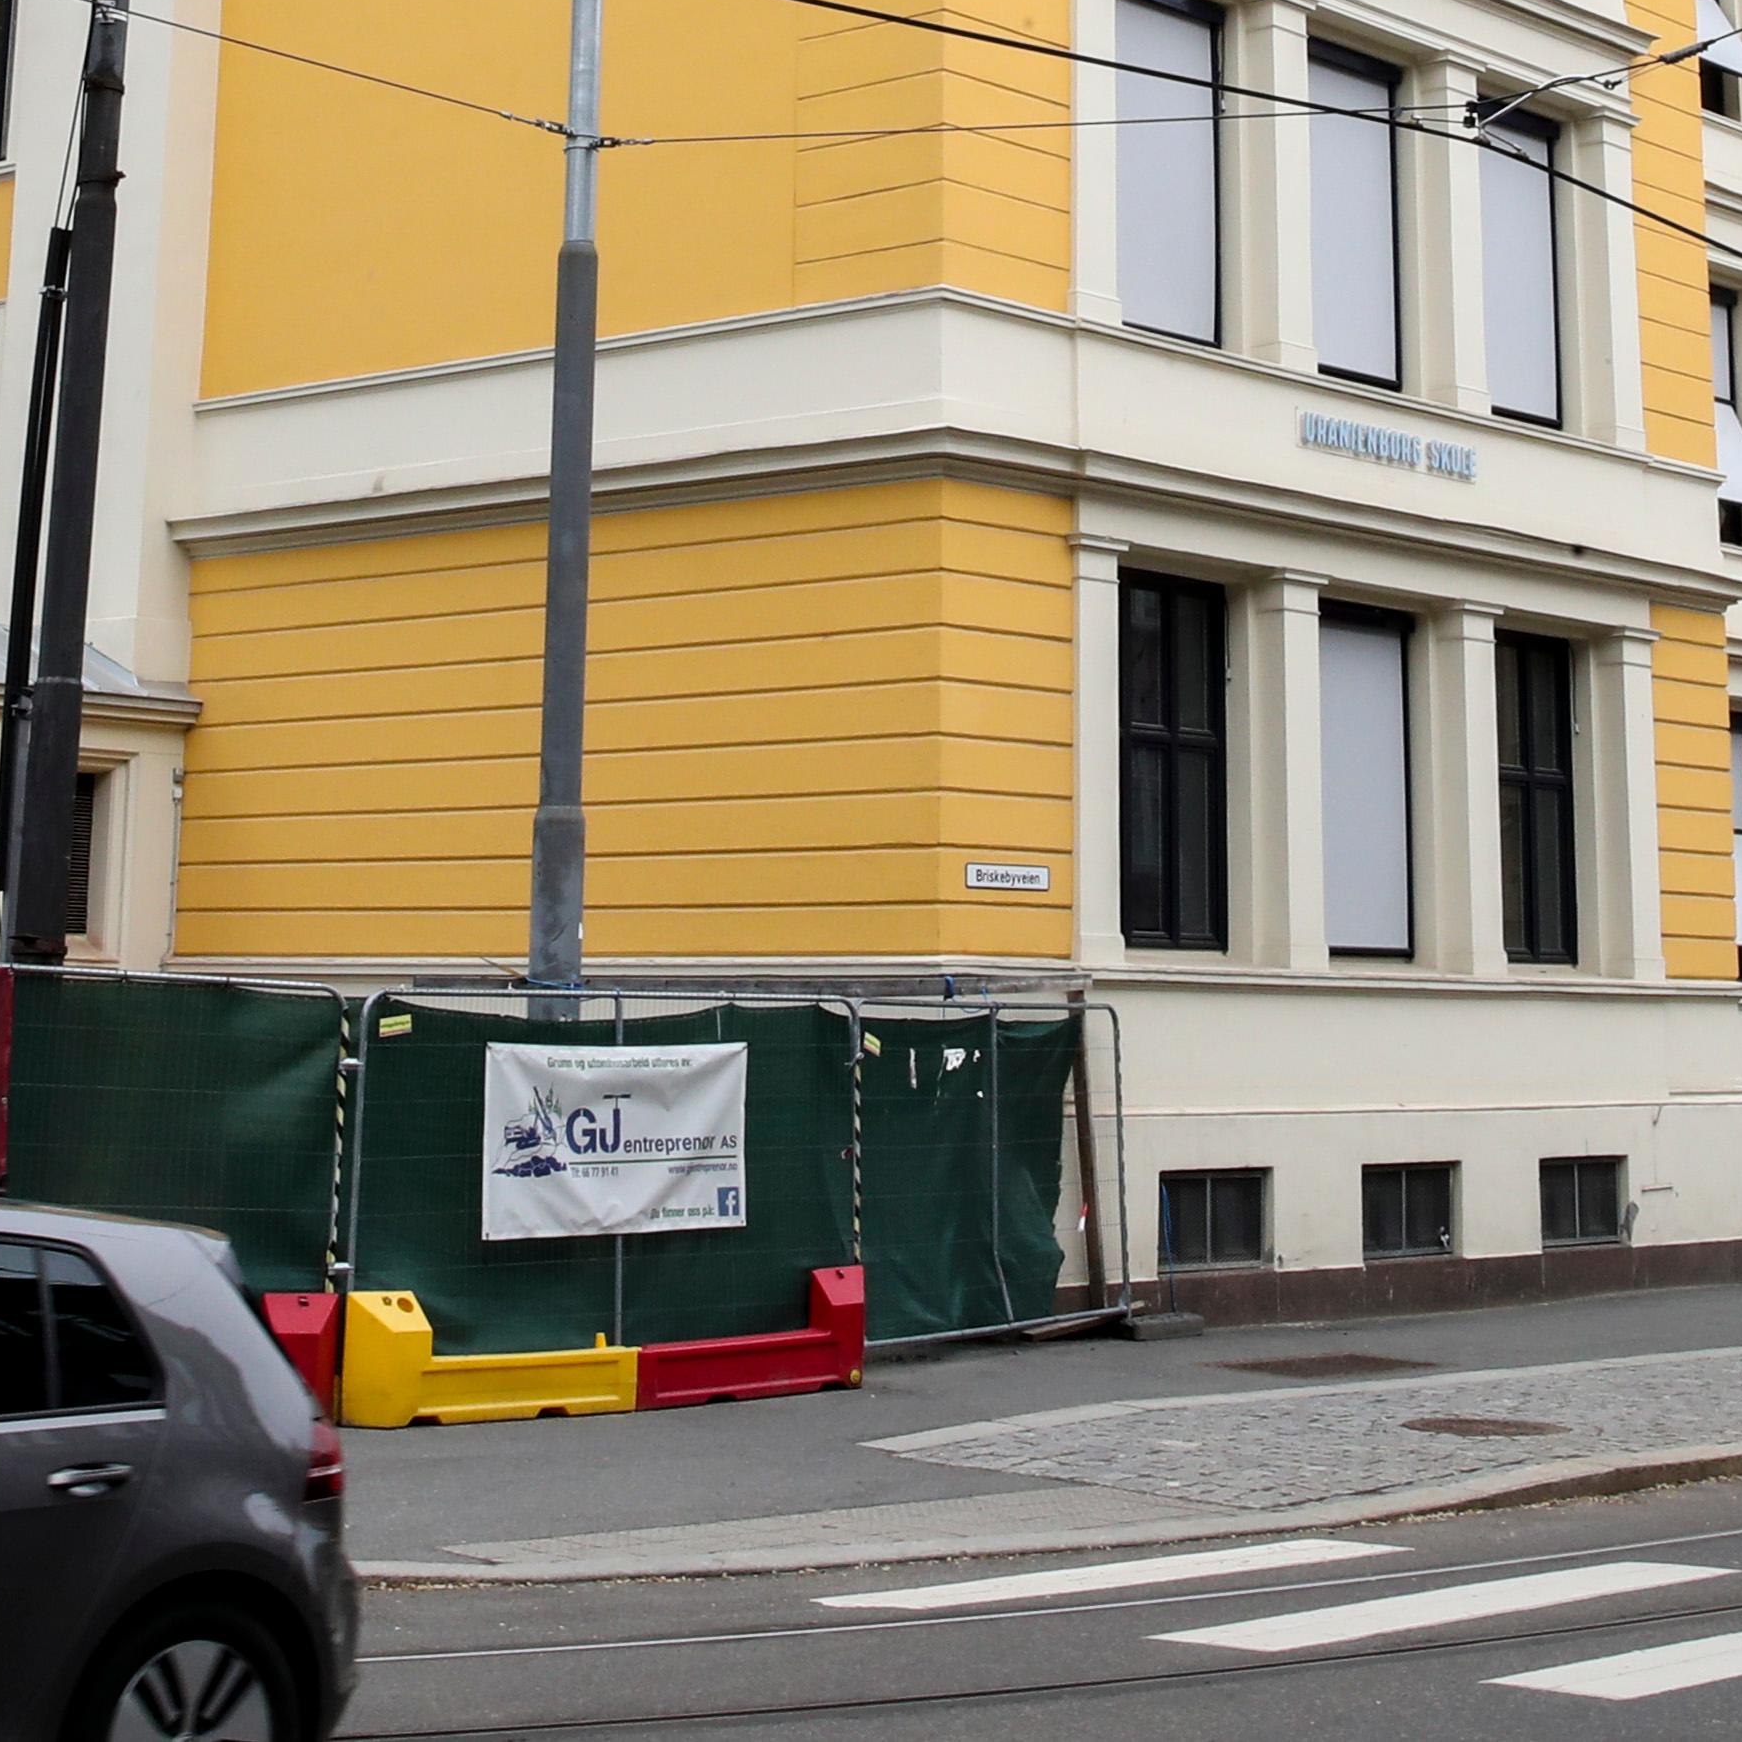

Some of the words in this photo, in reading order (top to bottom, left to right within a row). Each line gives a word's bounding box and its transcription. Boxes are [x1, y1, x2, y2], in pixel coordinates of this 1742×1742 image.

[1302, 412, 1422, 466] URANIENBORG
[1428, 439, 1477, 477] SKOLE
[975, 868, 1040, 886] Briskebyveien
[623, 1136, 715, 1155] entreprenør
[720, 1135, 737, 1149] AS
[591, 1167, 599, 1177] 77
